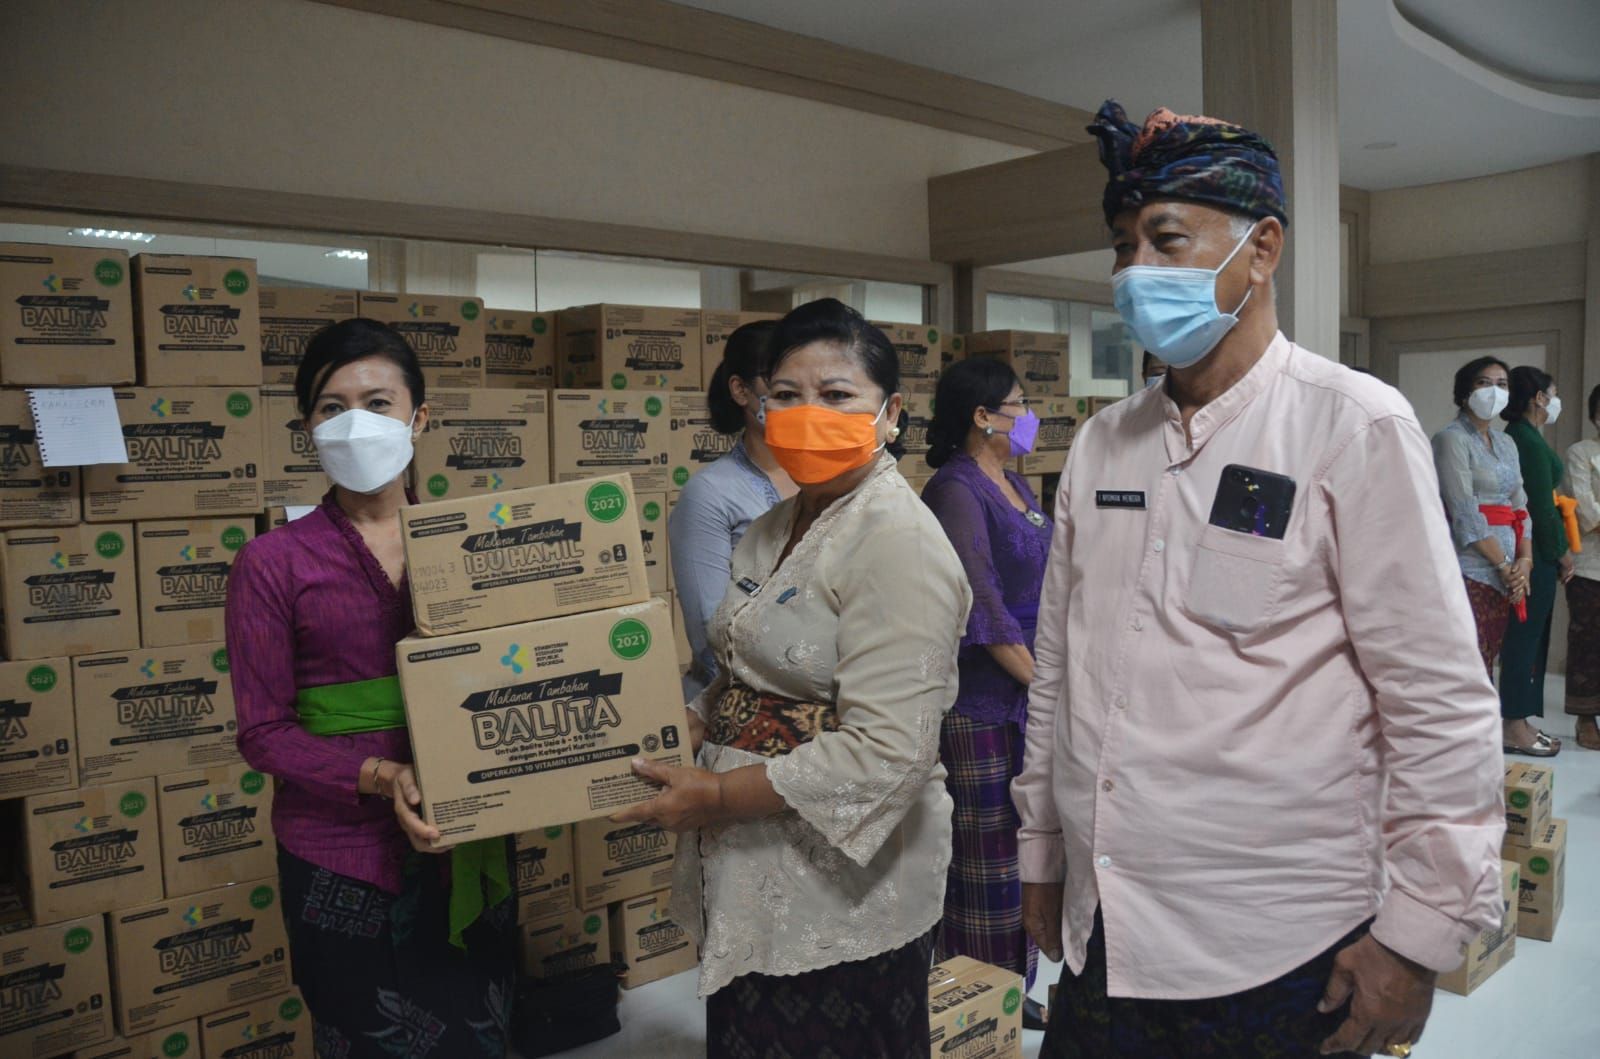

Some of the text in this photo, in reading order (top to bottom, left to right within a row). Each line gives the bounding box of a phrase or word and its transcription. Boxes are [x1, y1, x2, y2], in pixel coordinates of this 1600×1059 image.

[21, 306, 107, 328] BALITA
[164, 315, 238, 335] BALITA
[403, 331, 457, 352] ALITA
[486, 343, 532, 362] ALITA
[127, 437, 222, 462] BALITA
[449, 436, 522, 457] BALITA
[582, 430, 645, 450] BALITA
[592, 498, 622, 511] 2021
[474, 525, 565, 550] Makanan Tambahan
[464, 539, 584, 575] IBU HAMIL
[29, 583, 112, 607] BALITA
[616, 634, 646, 648] 2021
[484, 677, 589, 708] Makanan Tambahan
[117, 693, 215, 725] BALITA
[471, 694, 622, 750] BALITA
[495, 746, 518, 756] Untuk
[520, 743, 542, 751] Balita
[508, 741, 596, 762] dengan Kategori Kurus
[480, 767, 523, 780] DIPERKAYA
[534, 759, 567, 771] VITAMIN
[569, 756, 585, 765] DAN
[592, 748, 627, 761] MINERAL
[183, 819, 255, 847] BALITA
[608, 830, 668, 860] BALITA
[55, 841, 136, 872] BALITA
[639, 925, 685, 950] BALITA
[160, 933, 250, 973] BALITA
